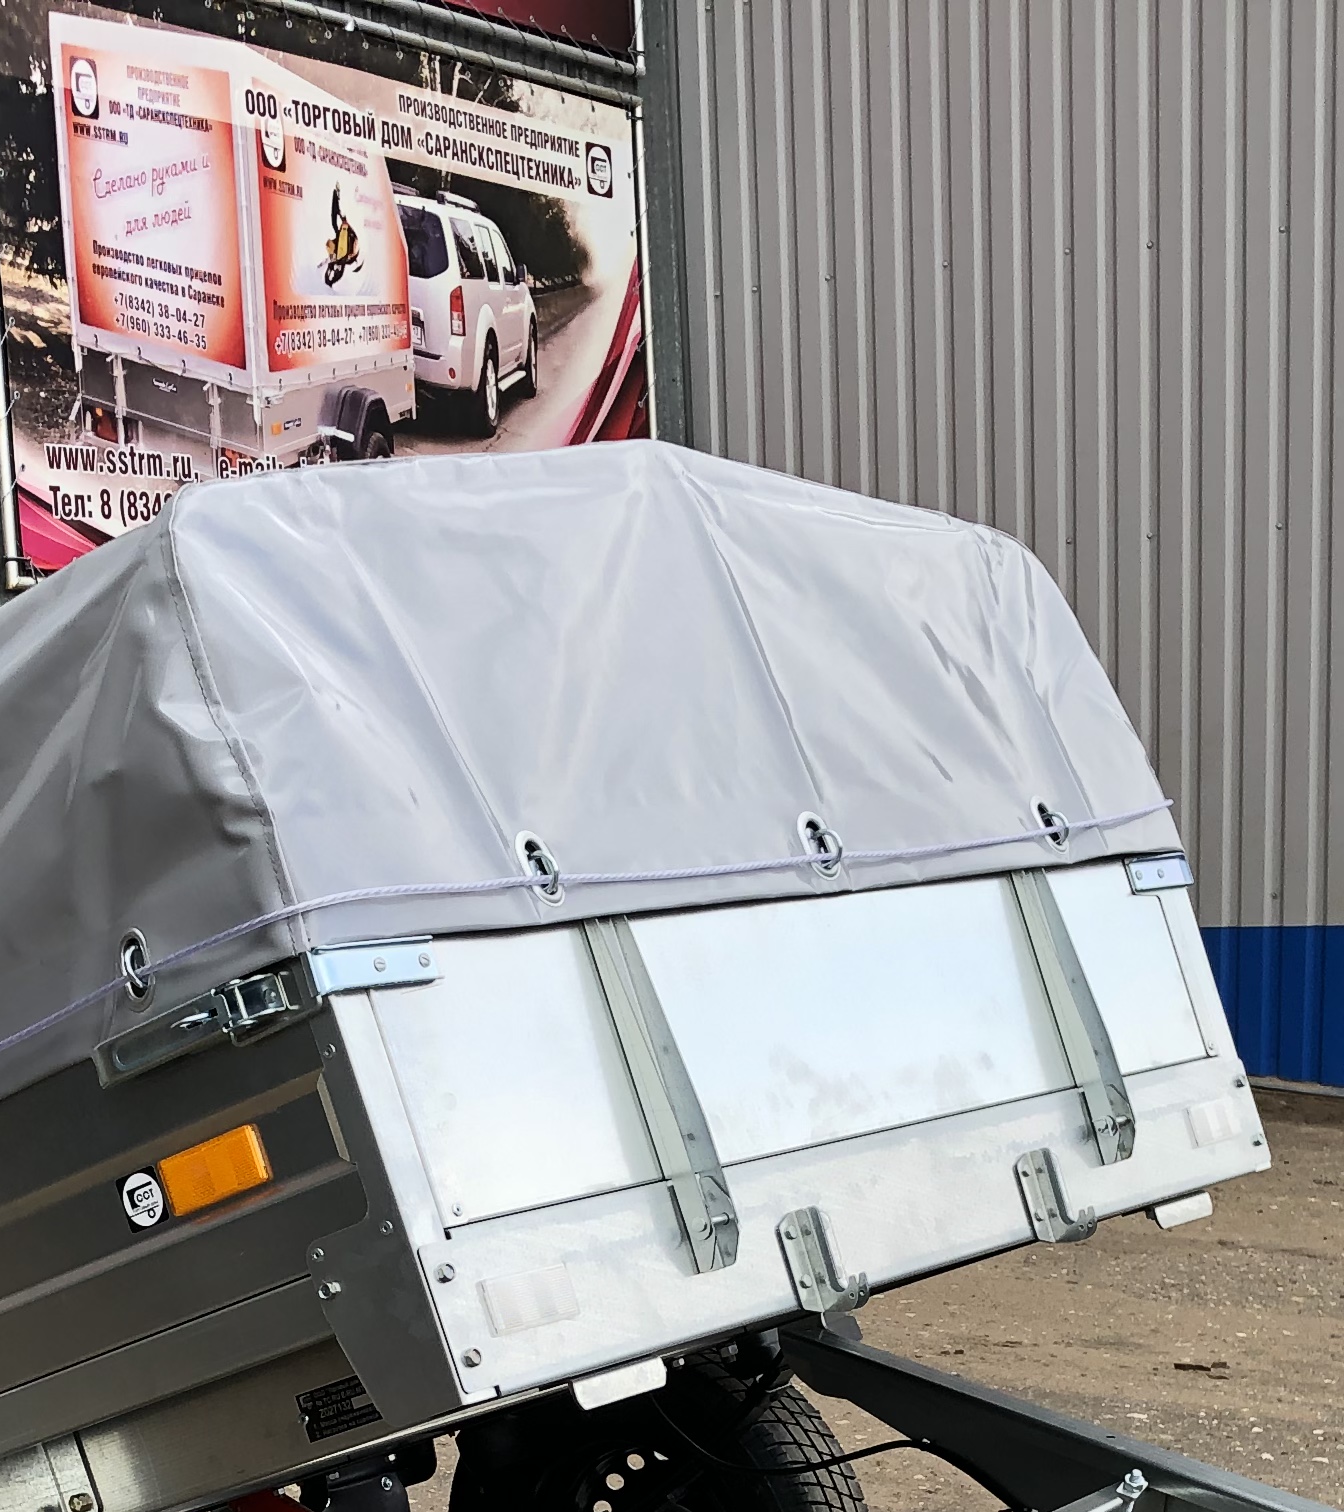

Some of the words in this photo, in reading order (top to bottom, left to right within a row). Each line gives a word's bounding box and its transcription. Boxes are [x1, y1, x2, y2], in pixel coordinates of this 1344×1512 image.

[244, 88, 278, 120] ООО
[283, 99, 377, 142] «ТОРГОВЫЙ
[381, 120, 413, 150] ДОМ
[417, 131, 582, 190] «САРАНСКСПЕЦТЕХНИКА»
[398, 93, 508, 140] ПРОИЗВОДСТВЕННОЕ
[510, 124, 580, 159] ПРЕДПРИЯТИЕ
[92, 168, 147, 199] Сделано
[151, 157, 198, 197] руками
[125, 218, 149, 237] для
[152, 200, 192, 229] людей
[92, 239, 145, 267] Производство
[146, 255, 183, 277] легковых
[184, 264, 223, 287] прицепов
[144, 275, 179, 297] качества
[114, 292, 155, 319] +7(8342)
[157, 302, 206, 329] 38-04-27
[115, 312, 151, 337] +7(960)
[153, 322, 208, 351] 333-46-35
[276, 329, 315, 354] +7(8342)
[45, 444, 200, 483] www.sstrm.ru,
[49, 485, 94, 521] Тел:
[100, 489, 112, 521] 8
